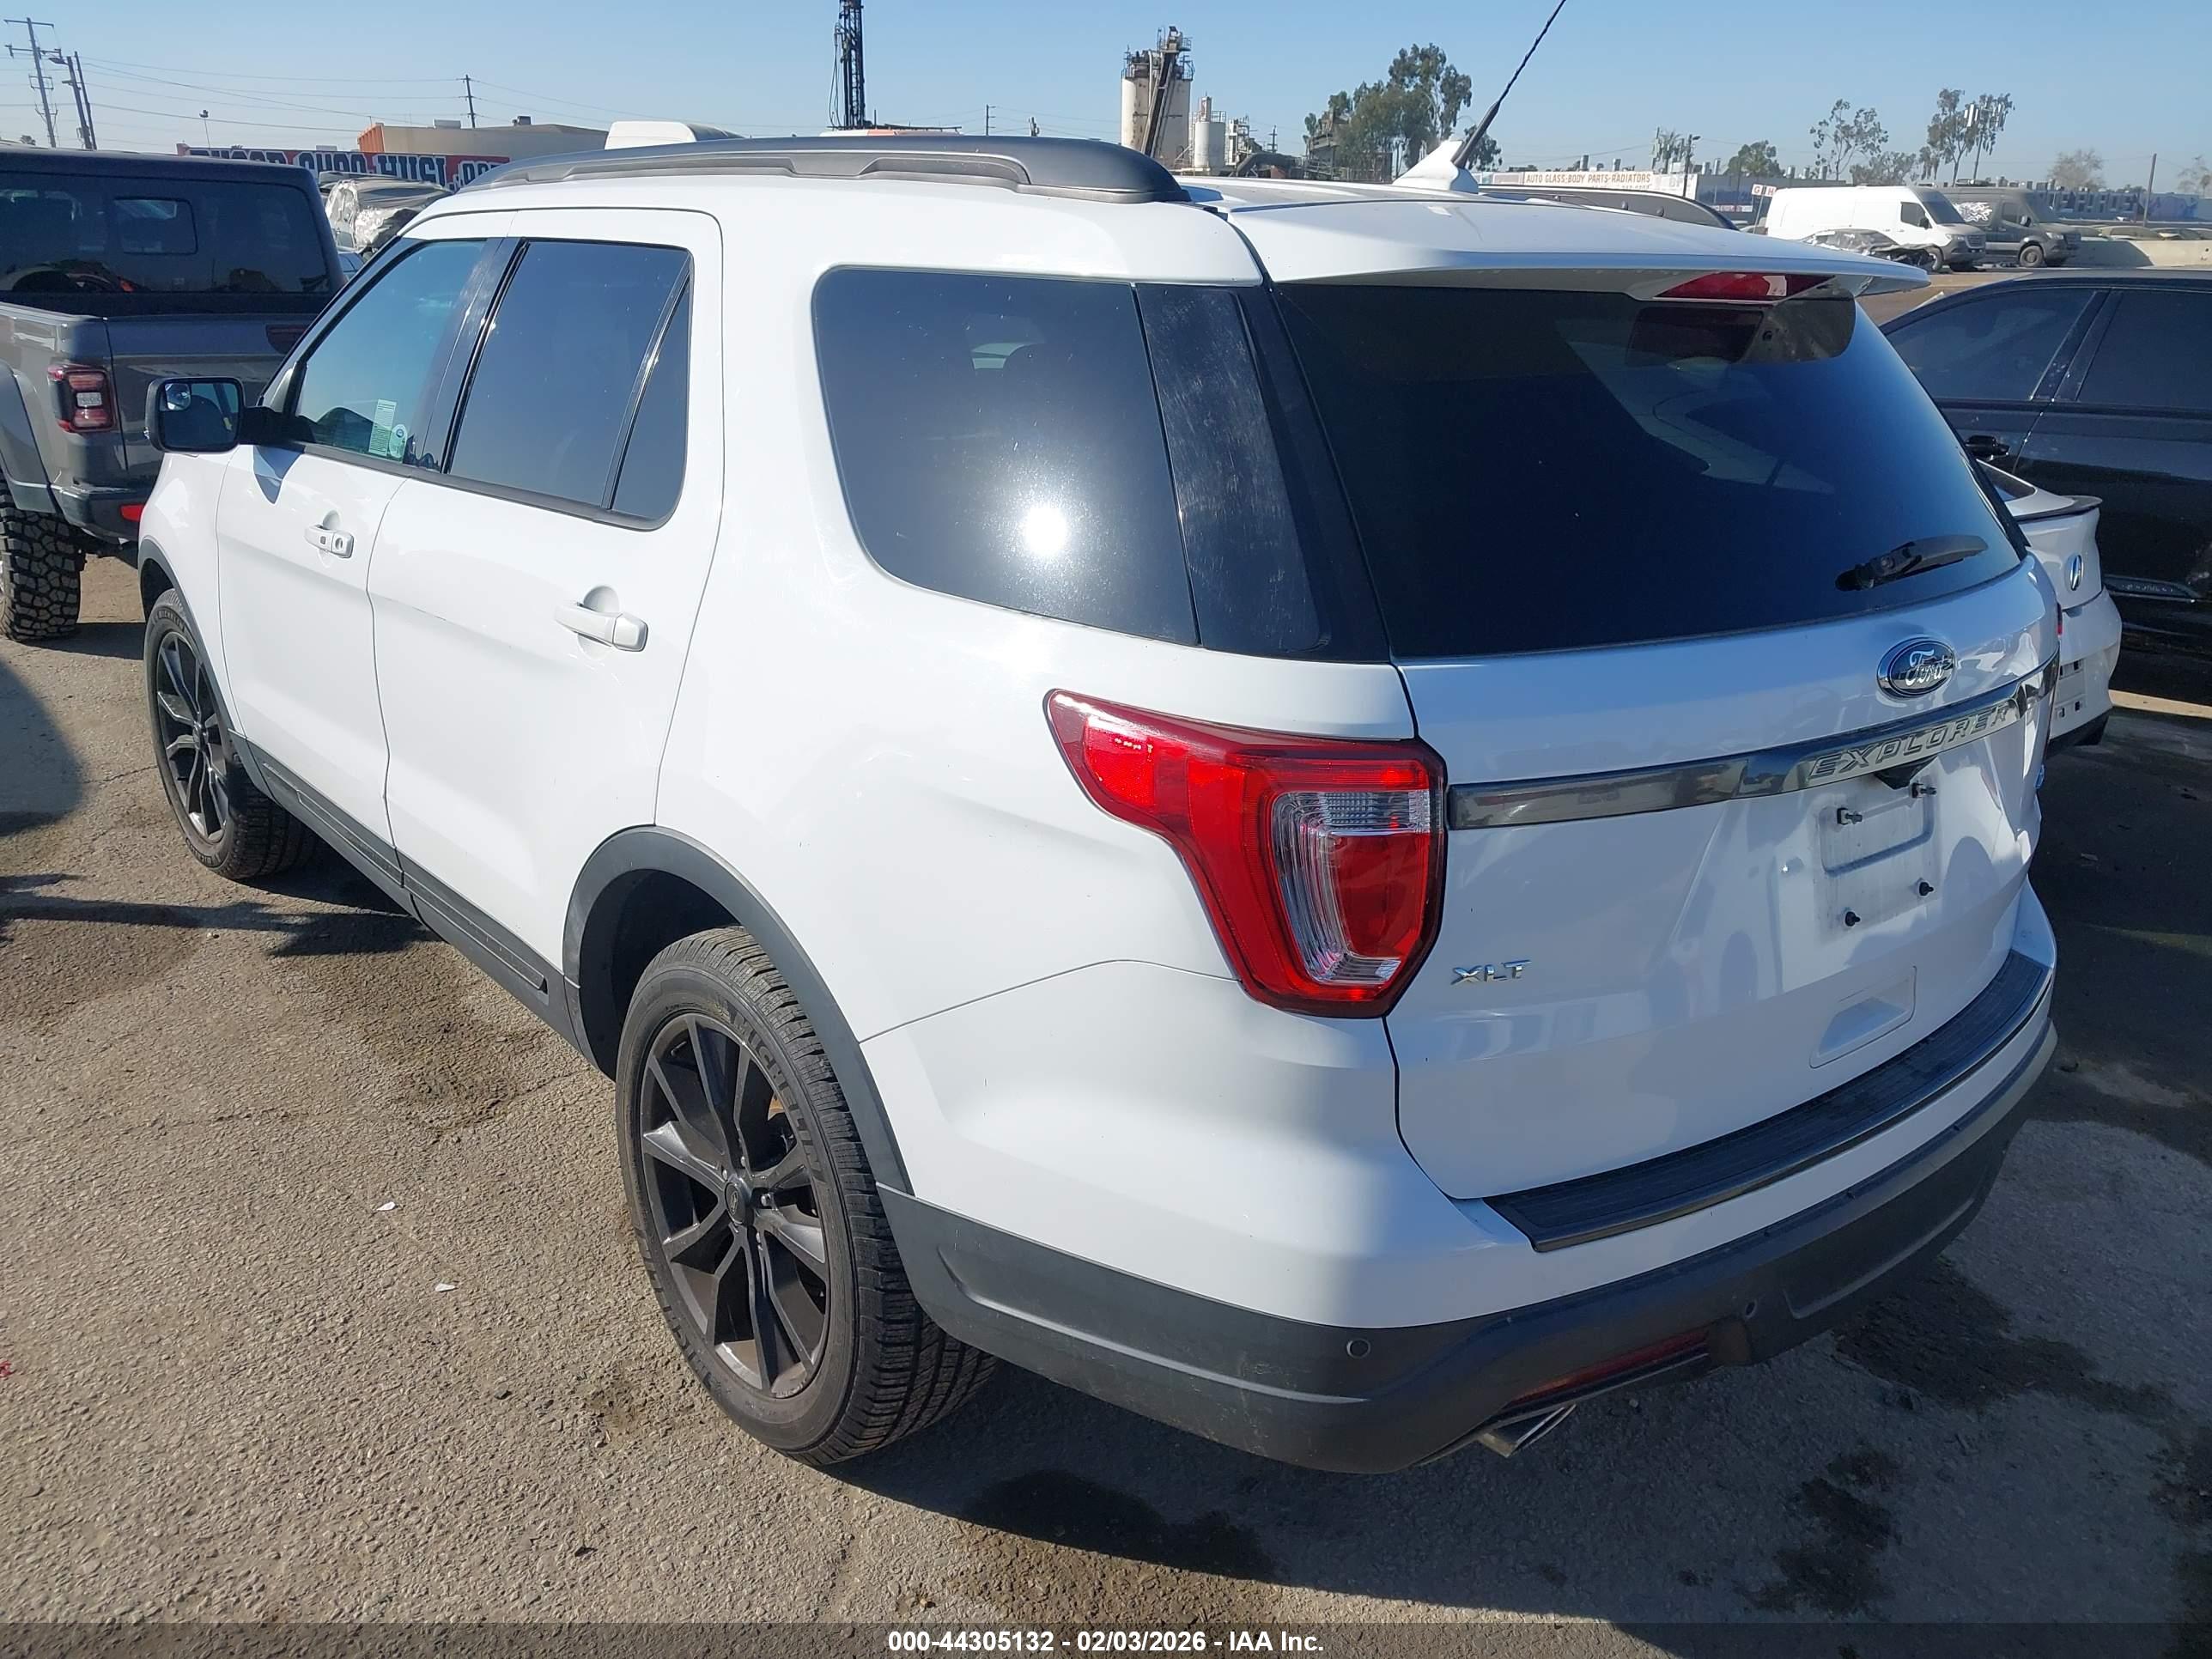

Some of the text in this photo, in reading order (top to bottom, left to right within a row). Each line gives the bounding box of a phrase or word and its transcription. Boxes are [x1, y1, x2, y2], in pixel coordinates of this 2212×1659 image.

[1526, 174, 1543, 183] AUTO
[1904, 649, 1953, 686] Ford
[1808, 705, 2010, 780] EXPLORER
[1450, 959, 1532, 986] XLT
